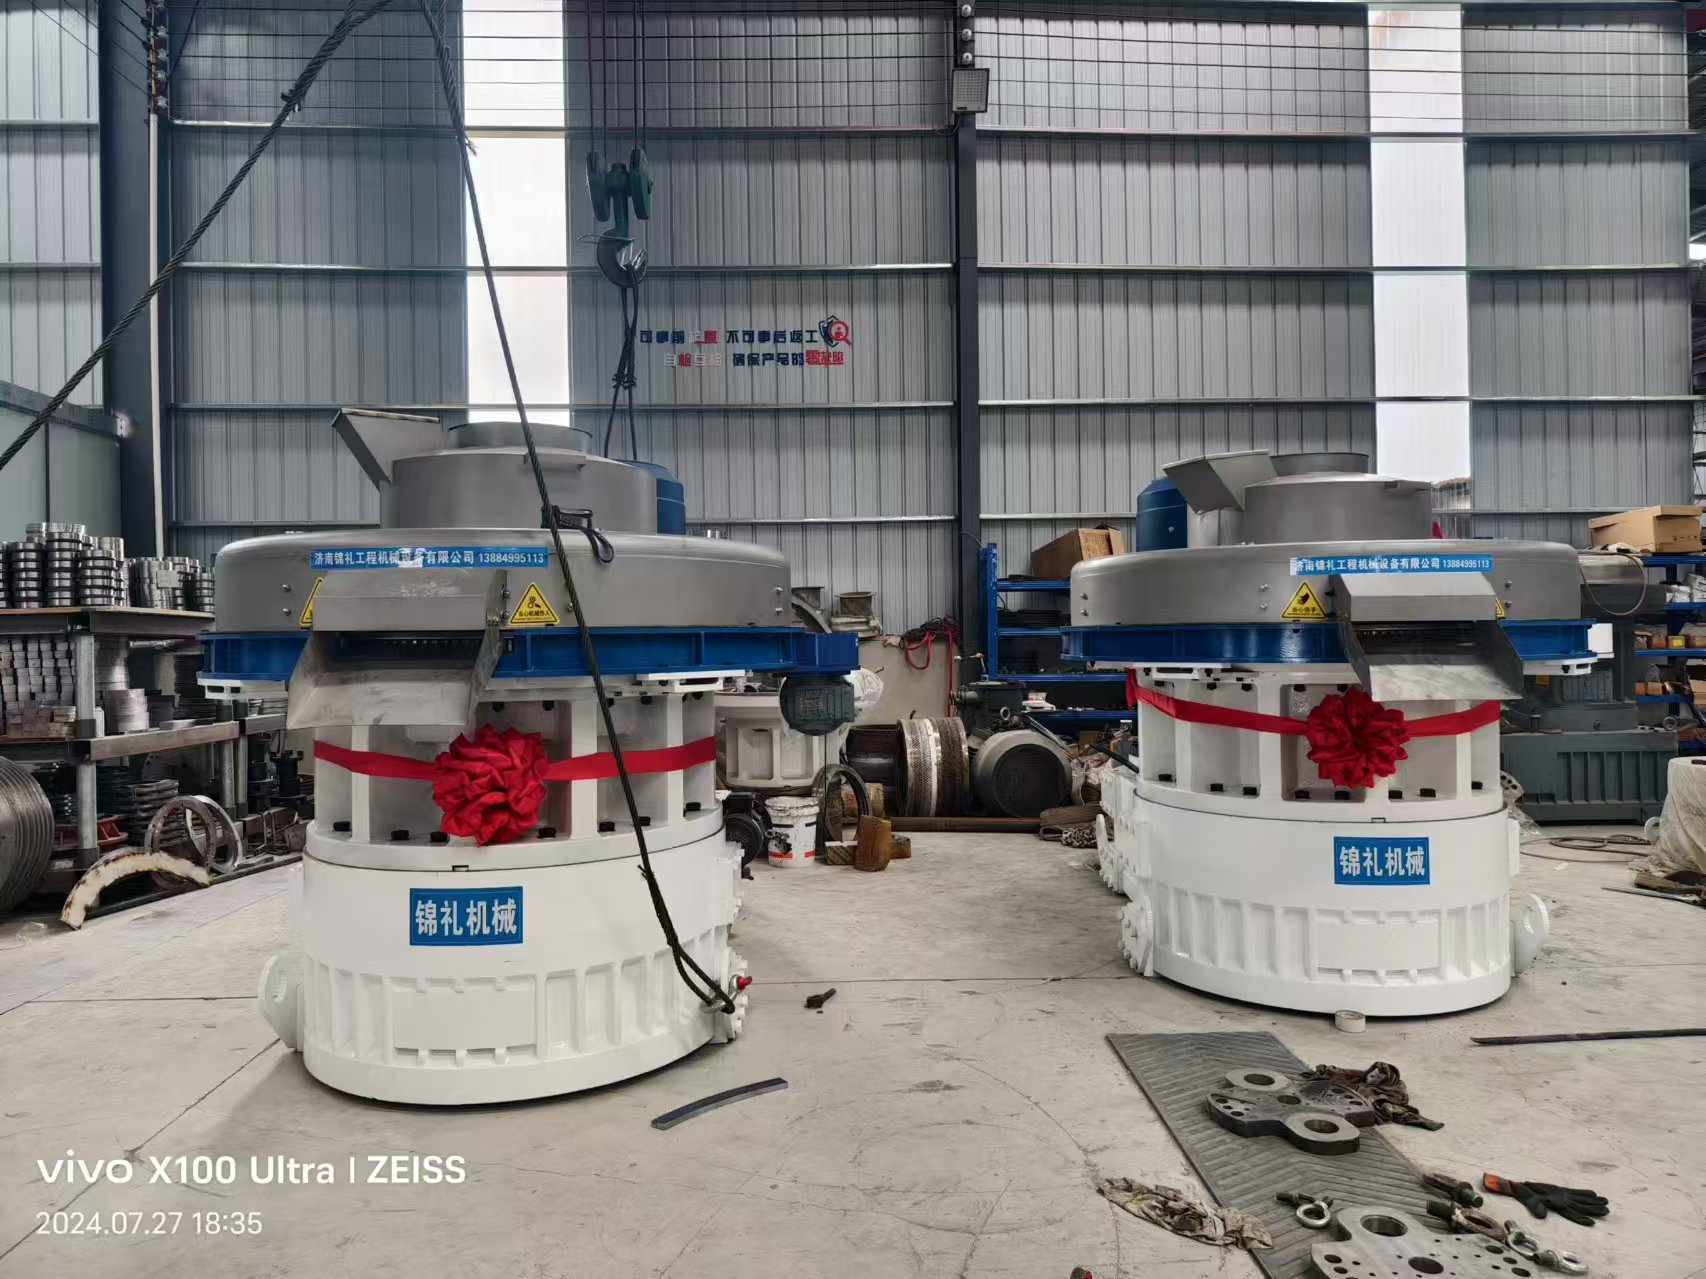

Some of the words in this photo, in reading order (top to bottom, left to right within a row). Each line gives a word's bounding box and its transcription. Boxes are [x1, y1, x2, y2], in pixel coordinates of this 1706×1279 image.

[314, 550, 474, 566] 济南锦礼工程机械设备有限公司
[478, 552, 544, 564] 13884995113
[1294, 558, 1441, 572] 济南锦礼工程机械设备有限公司
[1442, 559, 1490, 569] 13884995113
[1339, 845, 1425, 877] 锦礼机械
[415, 898, 517, 937] 锦礼机械
